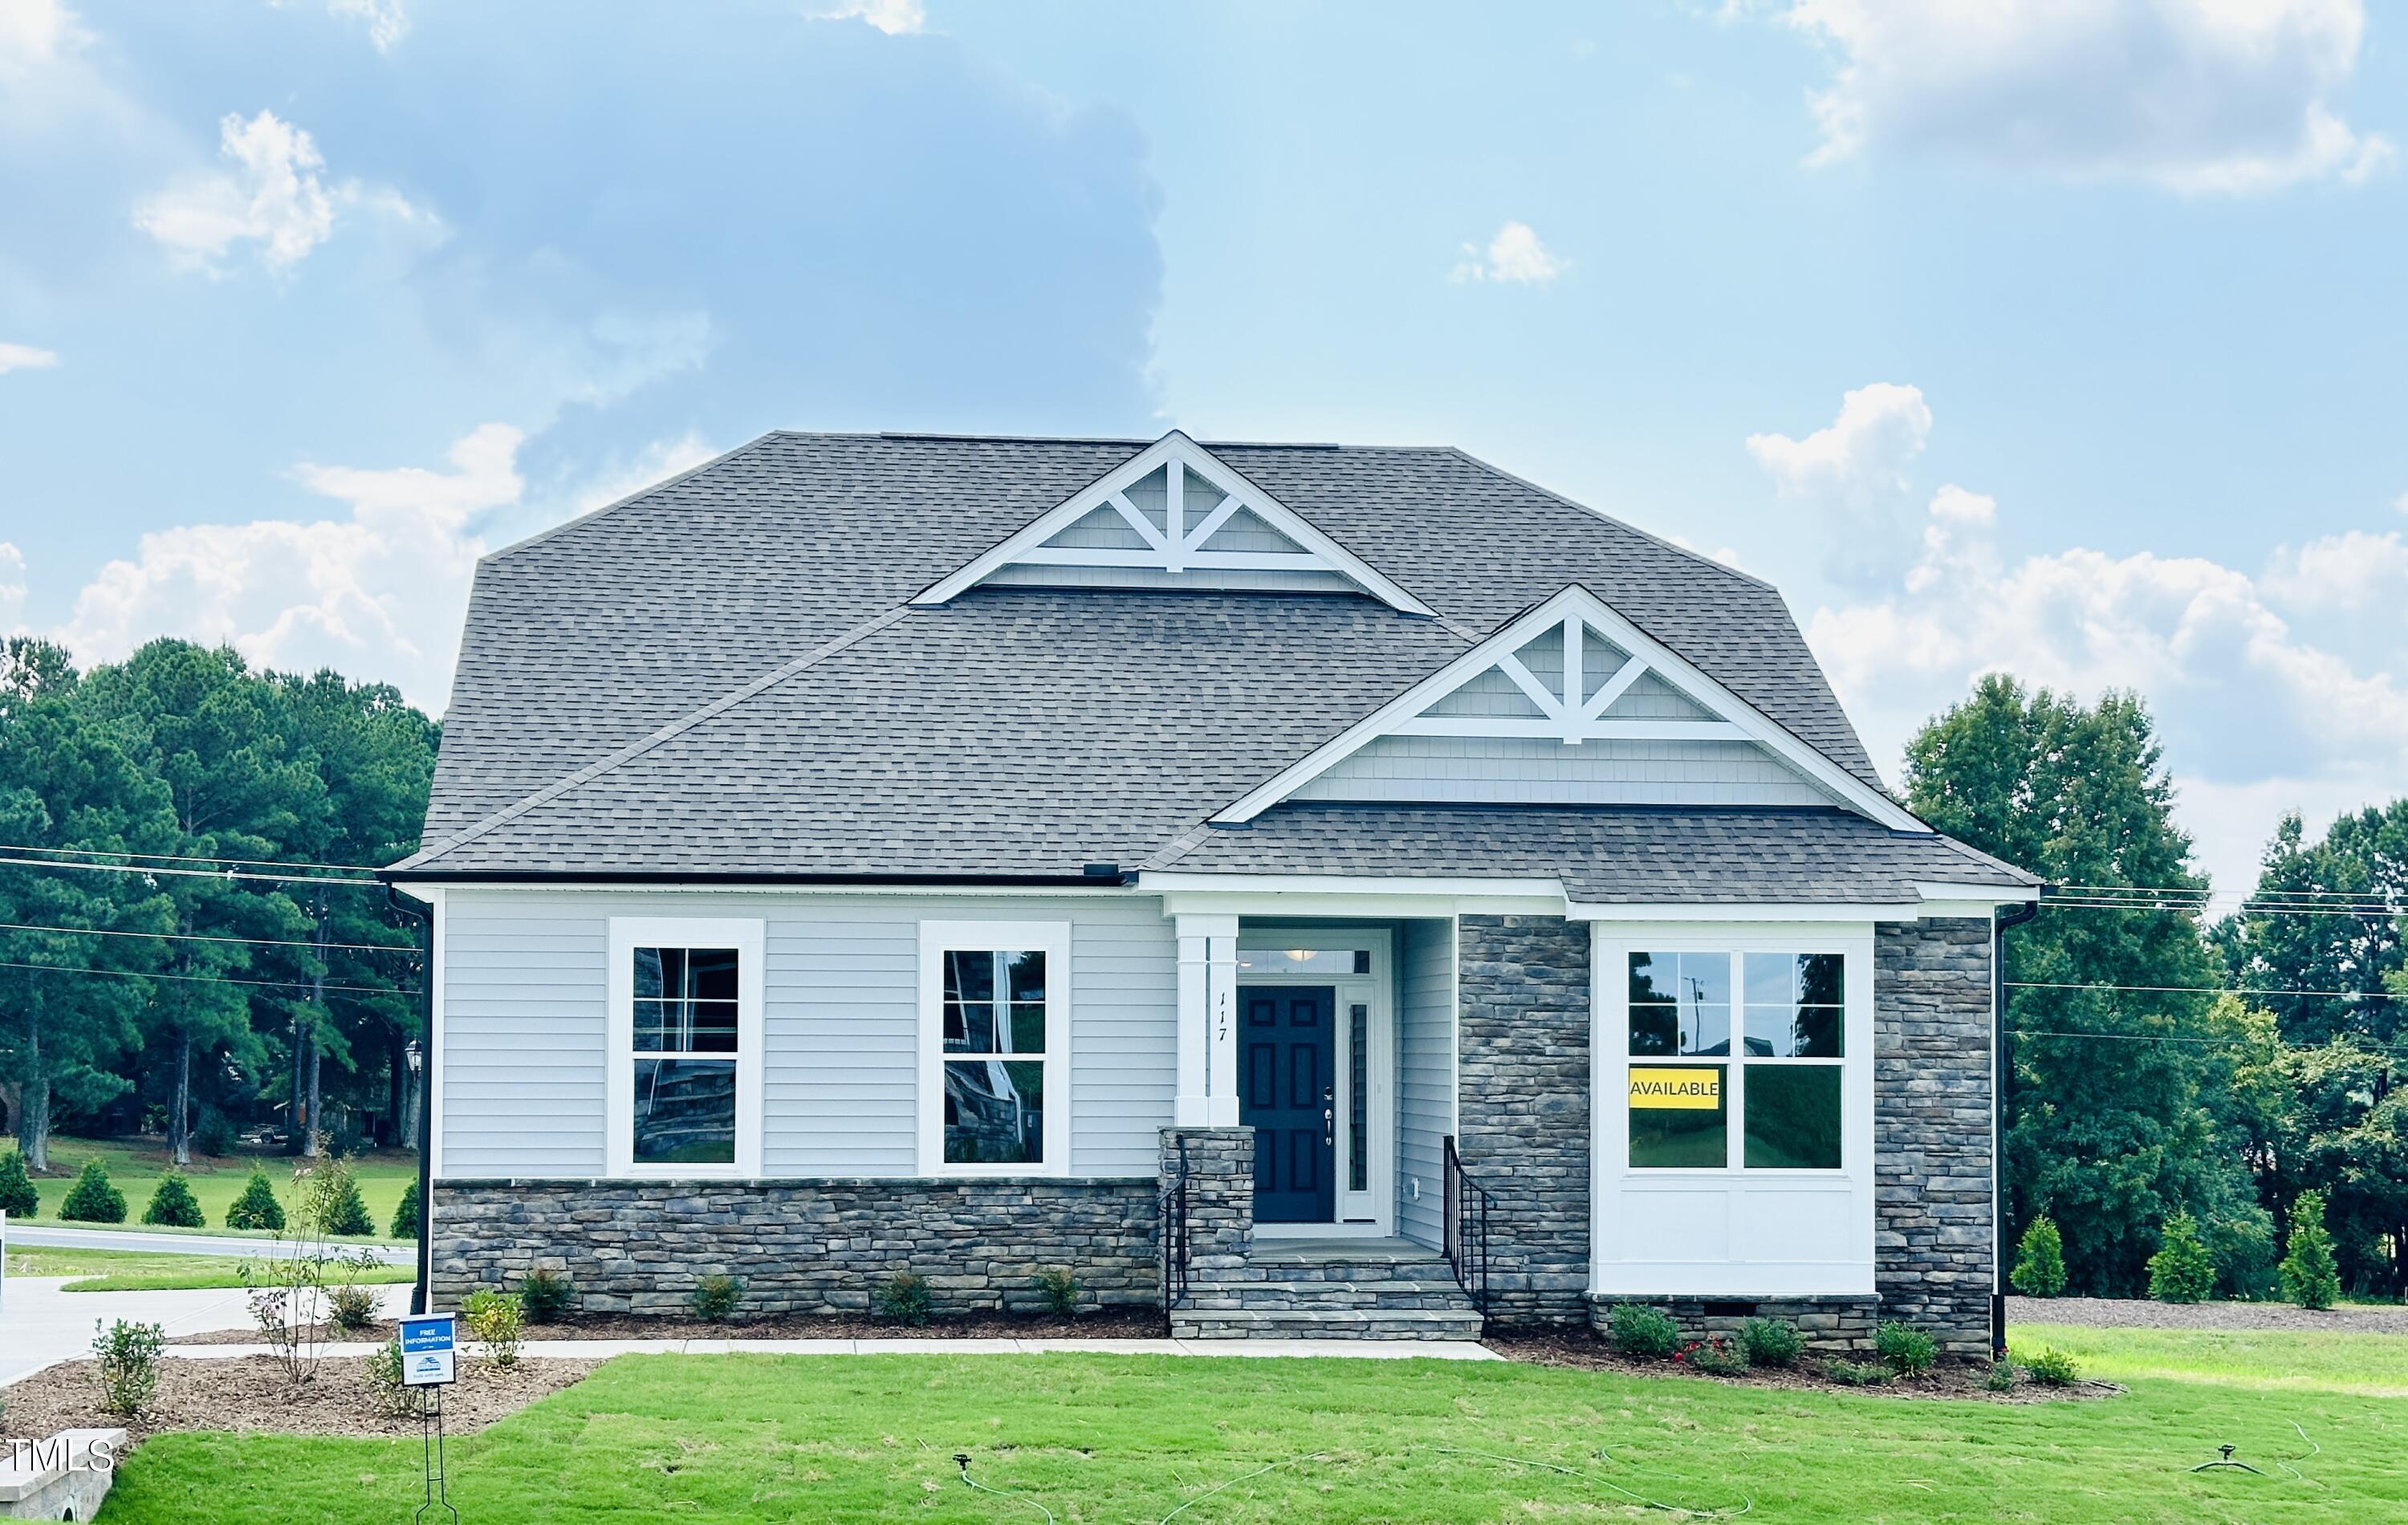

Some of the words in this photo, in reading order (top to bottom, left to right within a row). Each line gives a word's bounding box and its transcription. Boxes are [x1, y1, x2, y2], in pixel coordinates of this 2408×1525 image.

[1219, 992, 1227, 1042] 117
[1630, 1081, 1719, 1096] AVAILABLE
[419, 1328, 436, 1336] FREE
[405, 1336, 451, 1345] INFORMATION
